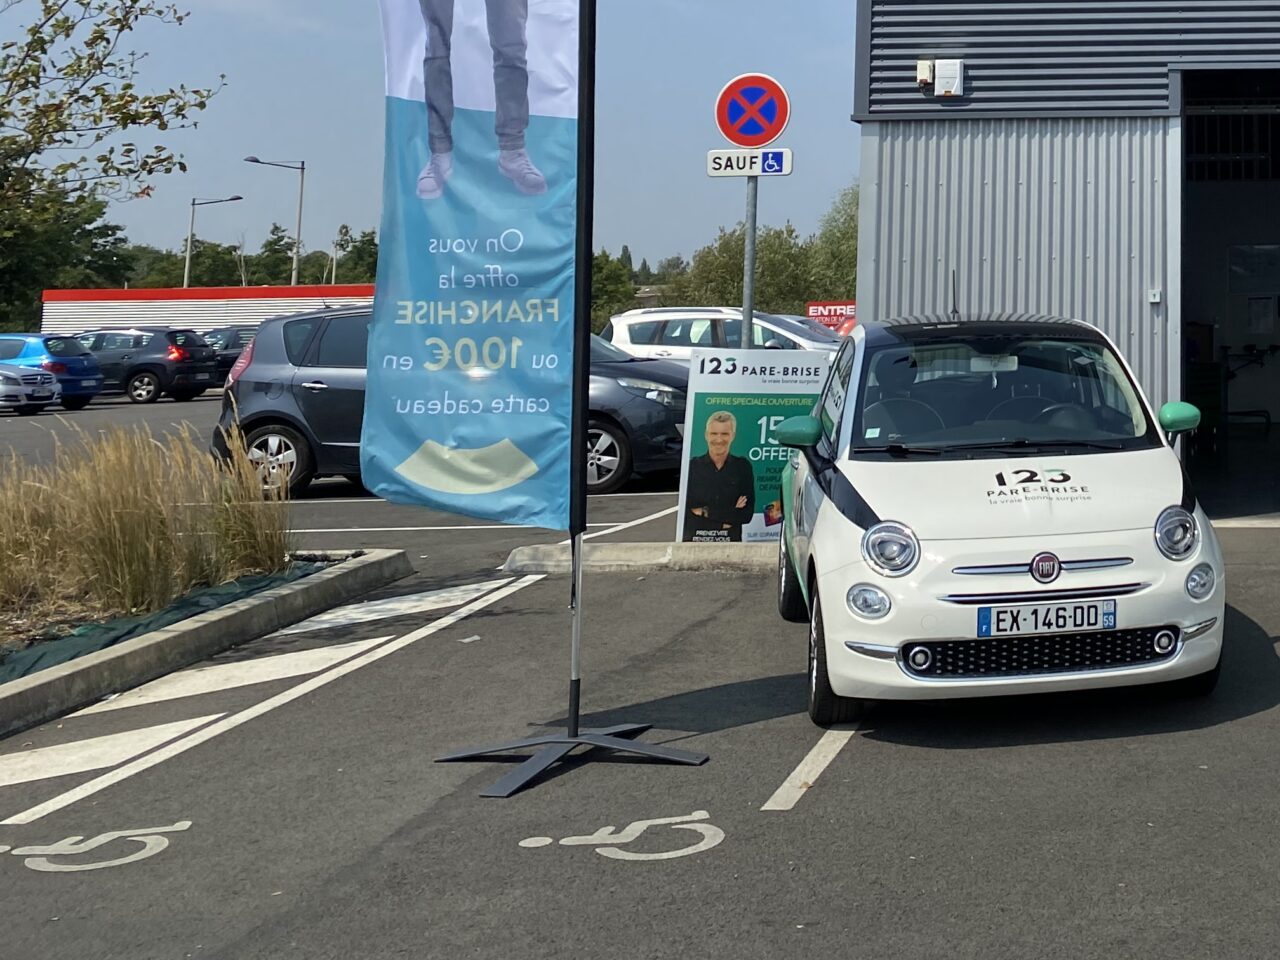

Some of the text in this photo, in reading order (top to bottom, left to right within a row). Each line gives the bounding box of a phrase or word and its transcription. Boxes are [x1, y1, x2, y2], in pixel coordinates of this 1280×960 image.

[712, 156, 759, 171] SAUF
[699, 357, 821, 377] 123 PARE-BRISE
[705, 396, 813, 406] OFFRE SPECIALE OUVERTURE
[995, 469, 1071, 486] 123
[986, 486, 1090, 497] PARE-BRISE
[1055, 495, 1092, 503] surprise
[1038, 561, 1055, 575] FIAT
[982, 605, 1115, 633] F EX-146-DD 59
